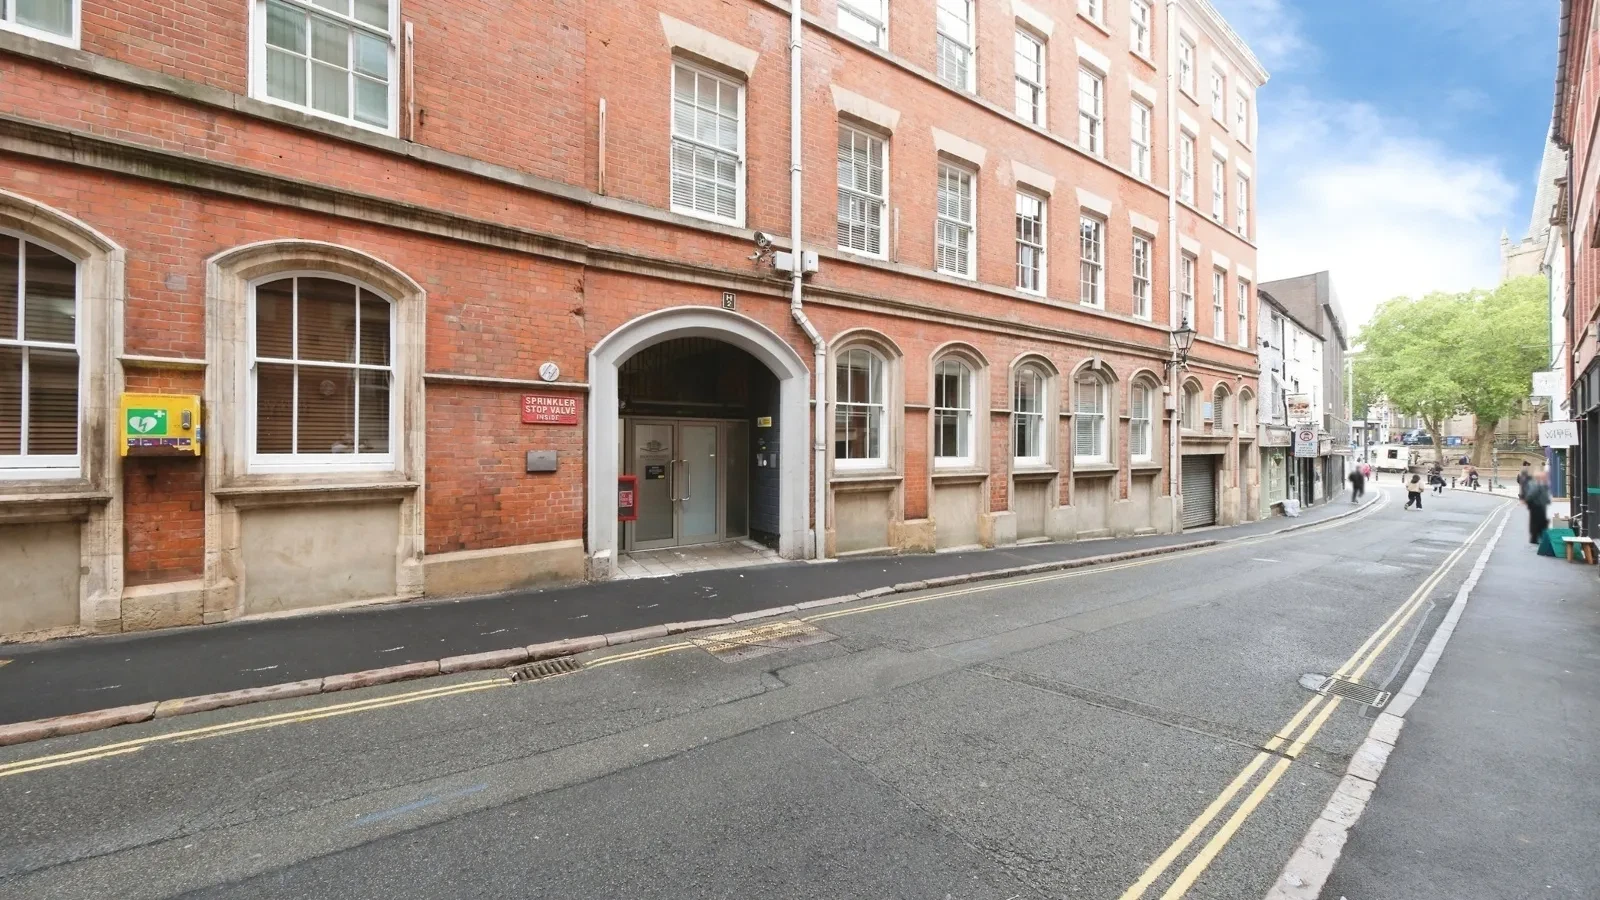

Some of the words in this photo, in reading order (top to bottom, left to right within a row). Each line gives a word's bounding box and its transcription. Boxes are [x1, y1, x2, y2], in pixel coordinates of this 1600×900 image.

[525, 397, 575, 406] SPRINKLER
[525, 405, 548, 413] STOP
[550, 406, 576, 414] VALVE
